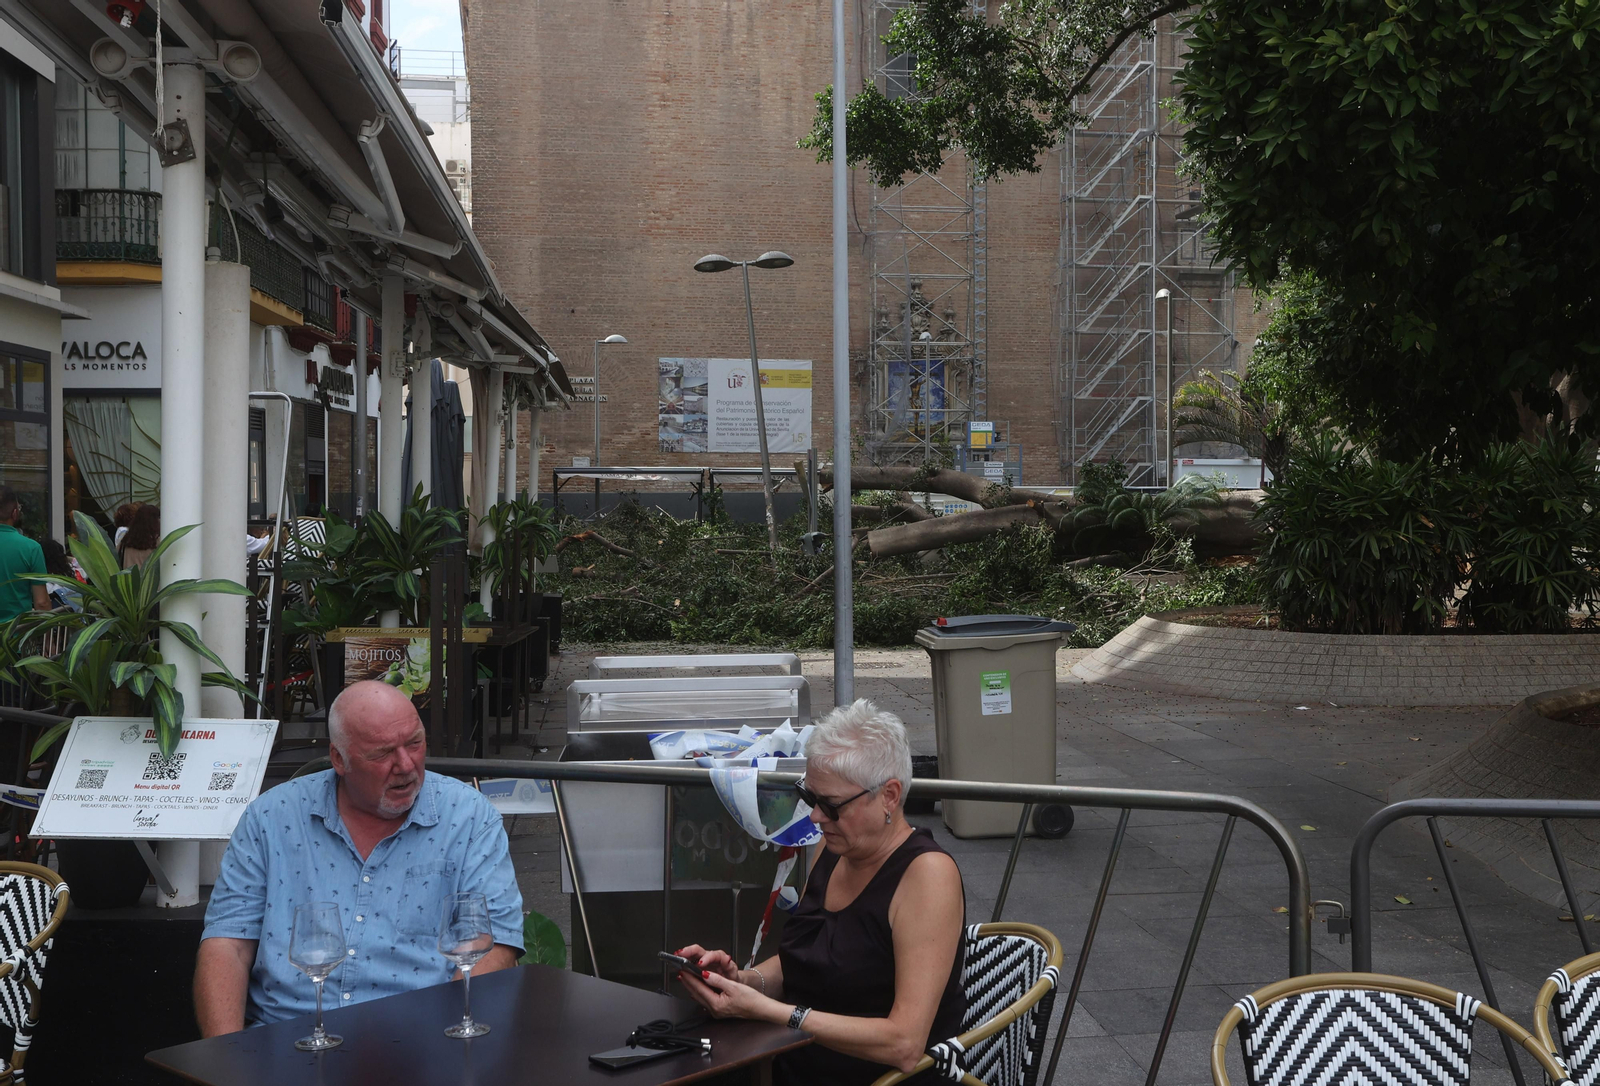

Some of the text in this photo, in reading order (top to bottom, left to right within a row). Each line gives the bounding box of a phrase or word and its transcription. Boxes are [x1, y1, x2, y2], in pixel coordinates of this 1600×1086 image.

[82, 363, 147, 371] MOMENTOS
[716, 399, 744, 407] Programa
[753, 399, 791, 407] Cnservación
[782, 407, 805, 415] Español
[348, 648, 401, 662] MOJITOS
[213, 761, 242, 769] Google
[51, 793, 249, 804] DESAYUNOS BRUNCH TAPAS COCTELES VINOS CENAS
